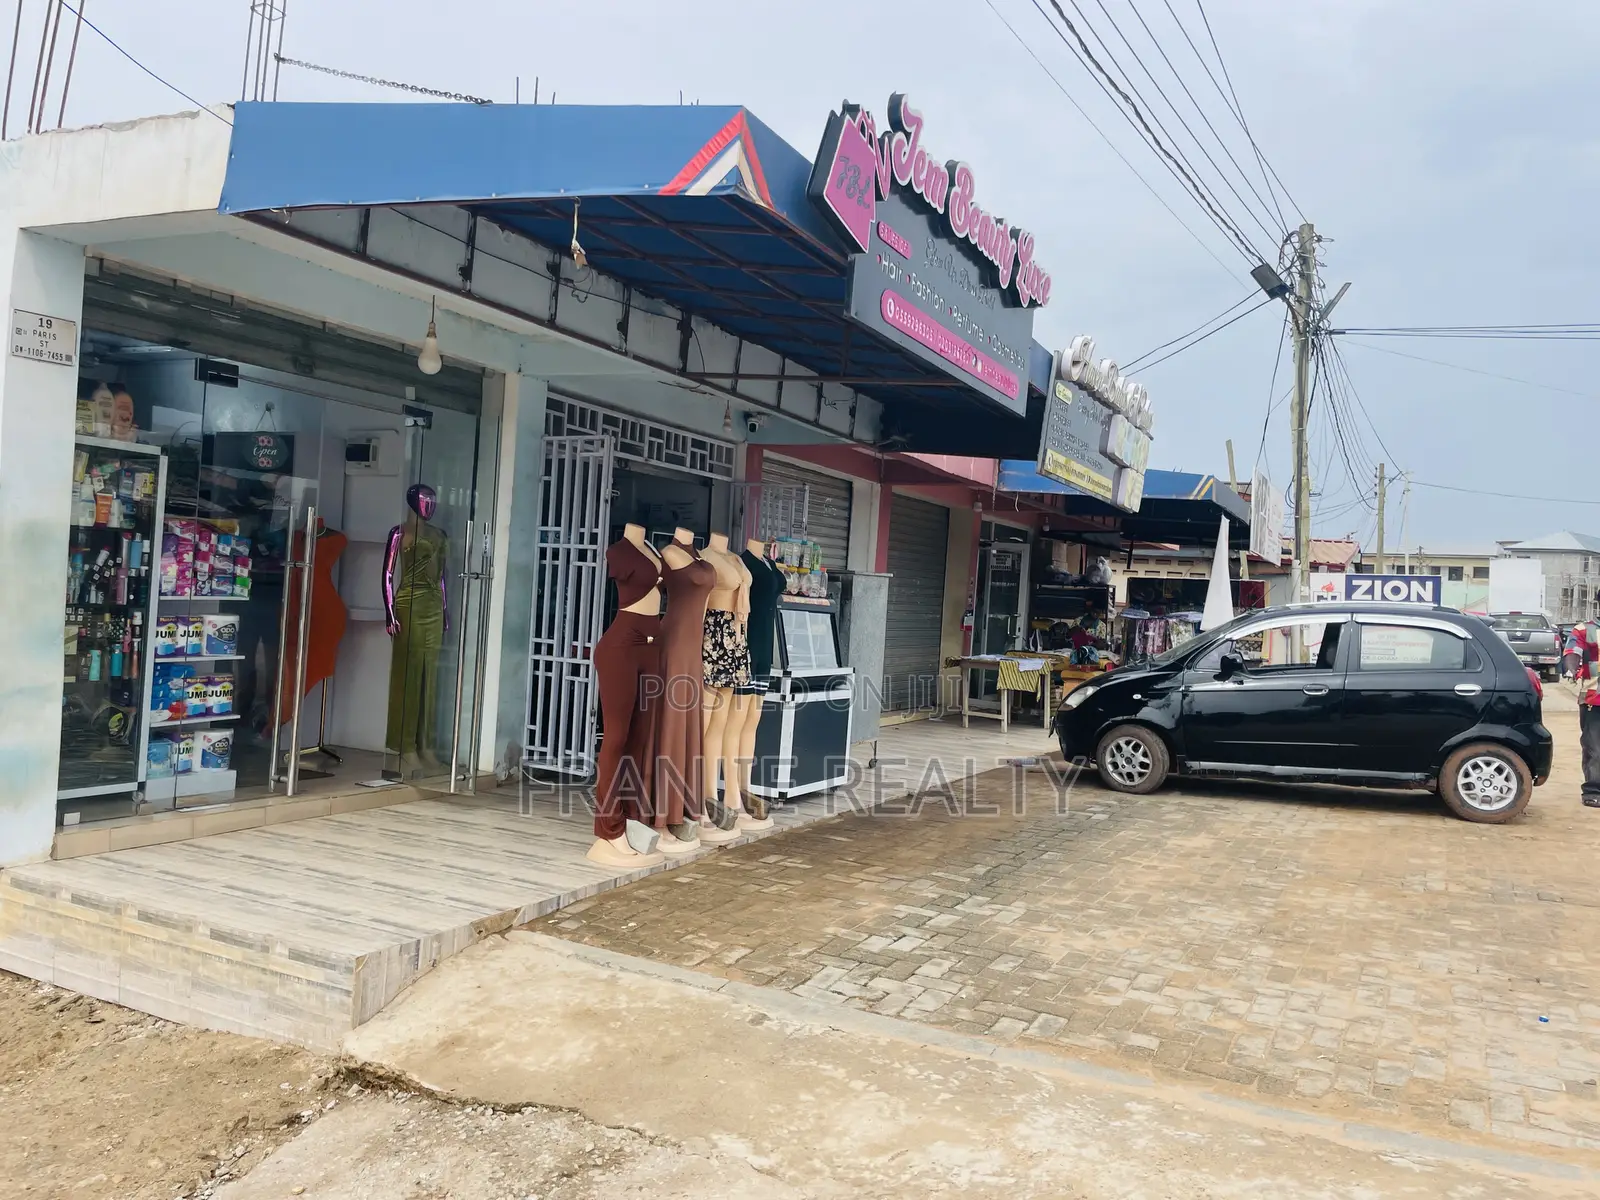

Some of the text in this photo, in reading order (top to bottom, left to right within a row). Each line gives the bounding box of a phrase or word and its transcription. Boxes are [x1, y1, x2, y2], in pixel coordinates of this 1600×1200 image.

[891, 93, 1052, 308] Jem Beauty Luxe
[881, 251, 1025, 371] Hair Fashion Perfume Cosmetics
[38, 317, 53, 330] 19
[32, 329, 57, 341] PARIS
[39, 340, 49, 348] ST
[253, 446, 278, 458] Open
[1351, 579, 1434, 602] ZION
